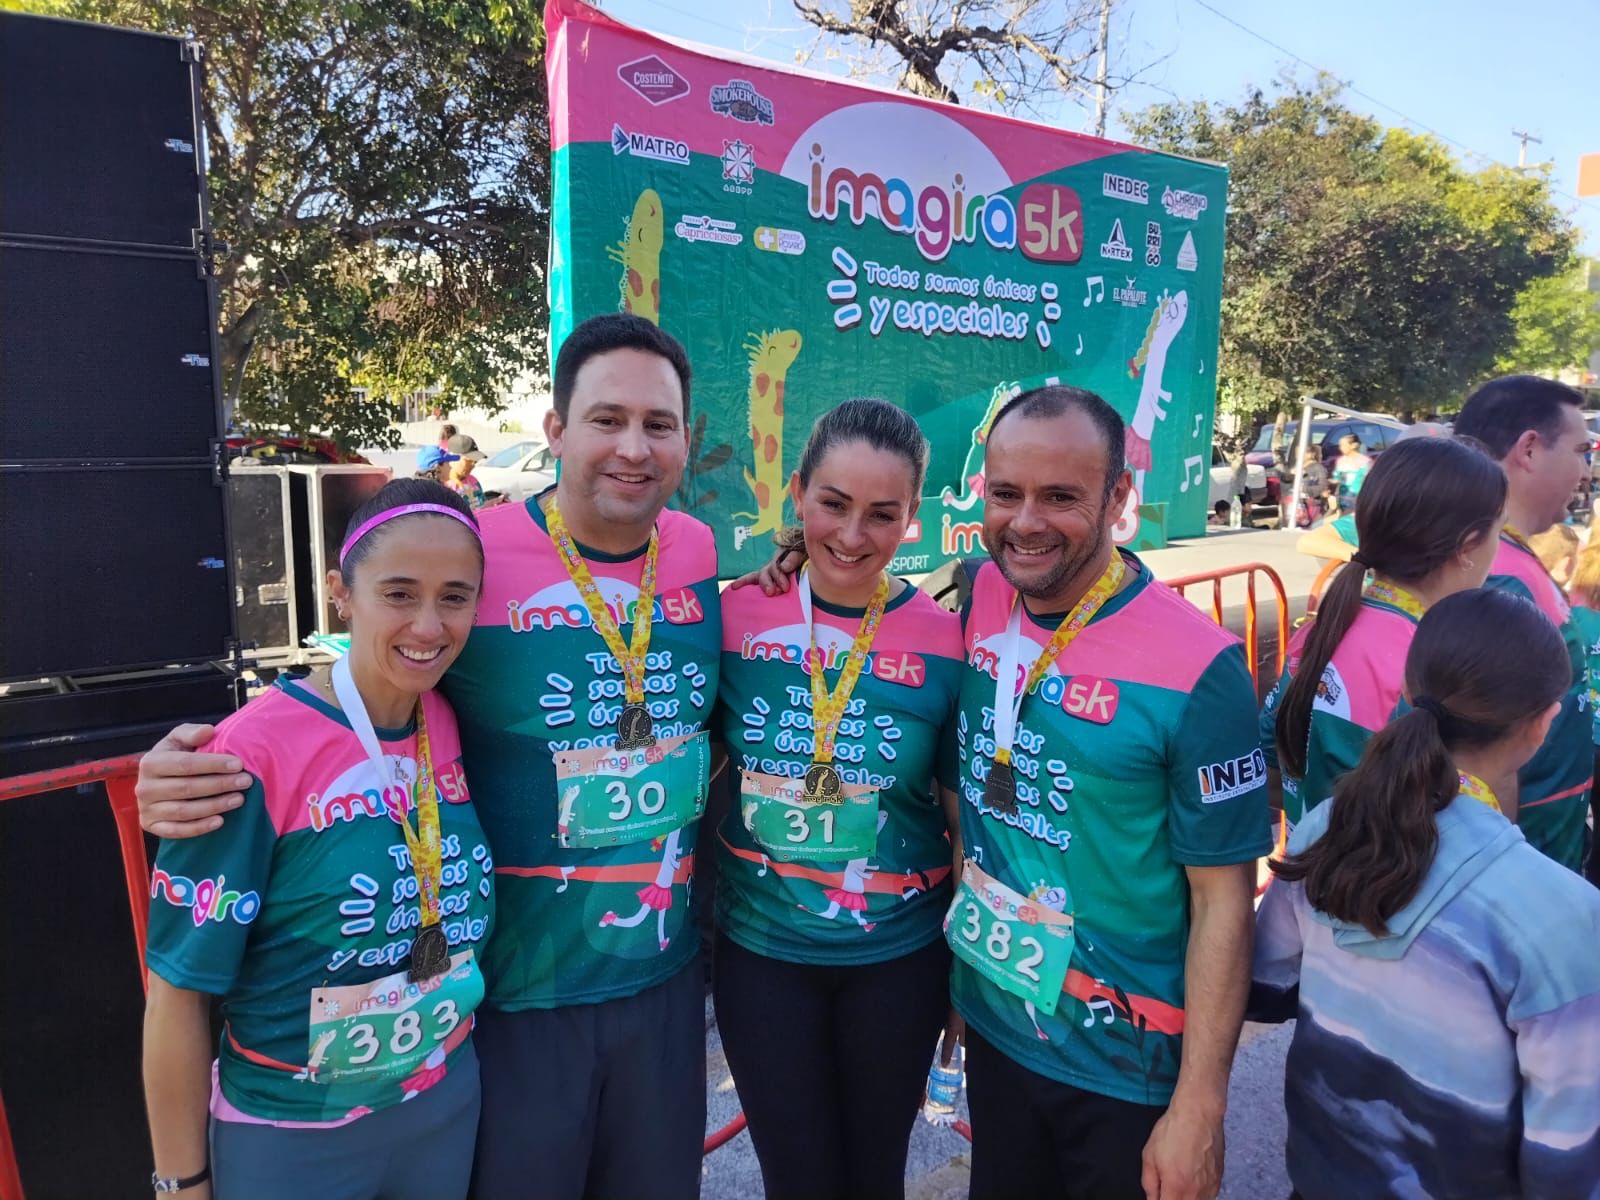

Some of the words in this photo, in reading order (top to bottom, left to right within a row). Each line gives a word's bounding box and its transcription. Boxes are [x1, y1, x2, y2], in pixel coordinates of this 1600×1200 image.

[631, 134, 688, 159] MATRO
[809, 143, 1016, 260] imagira
[1104, 174, 1148, 199] INEDEC
[864, 261, 920, 291] Todos
[924, 269, 979, 297] somos
[894, 298, 1029, 339] especiales
[605, 781, 666, 820] 30
[784, 809, 834, 843] 31
[961, 902, 1044, 982] 382
[346, 999, 460, 1064] 383
